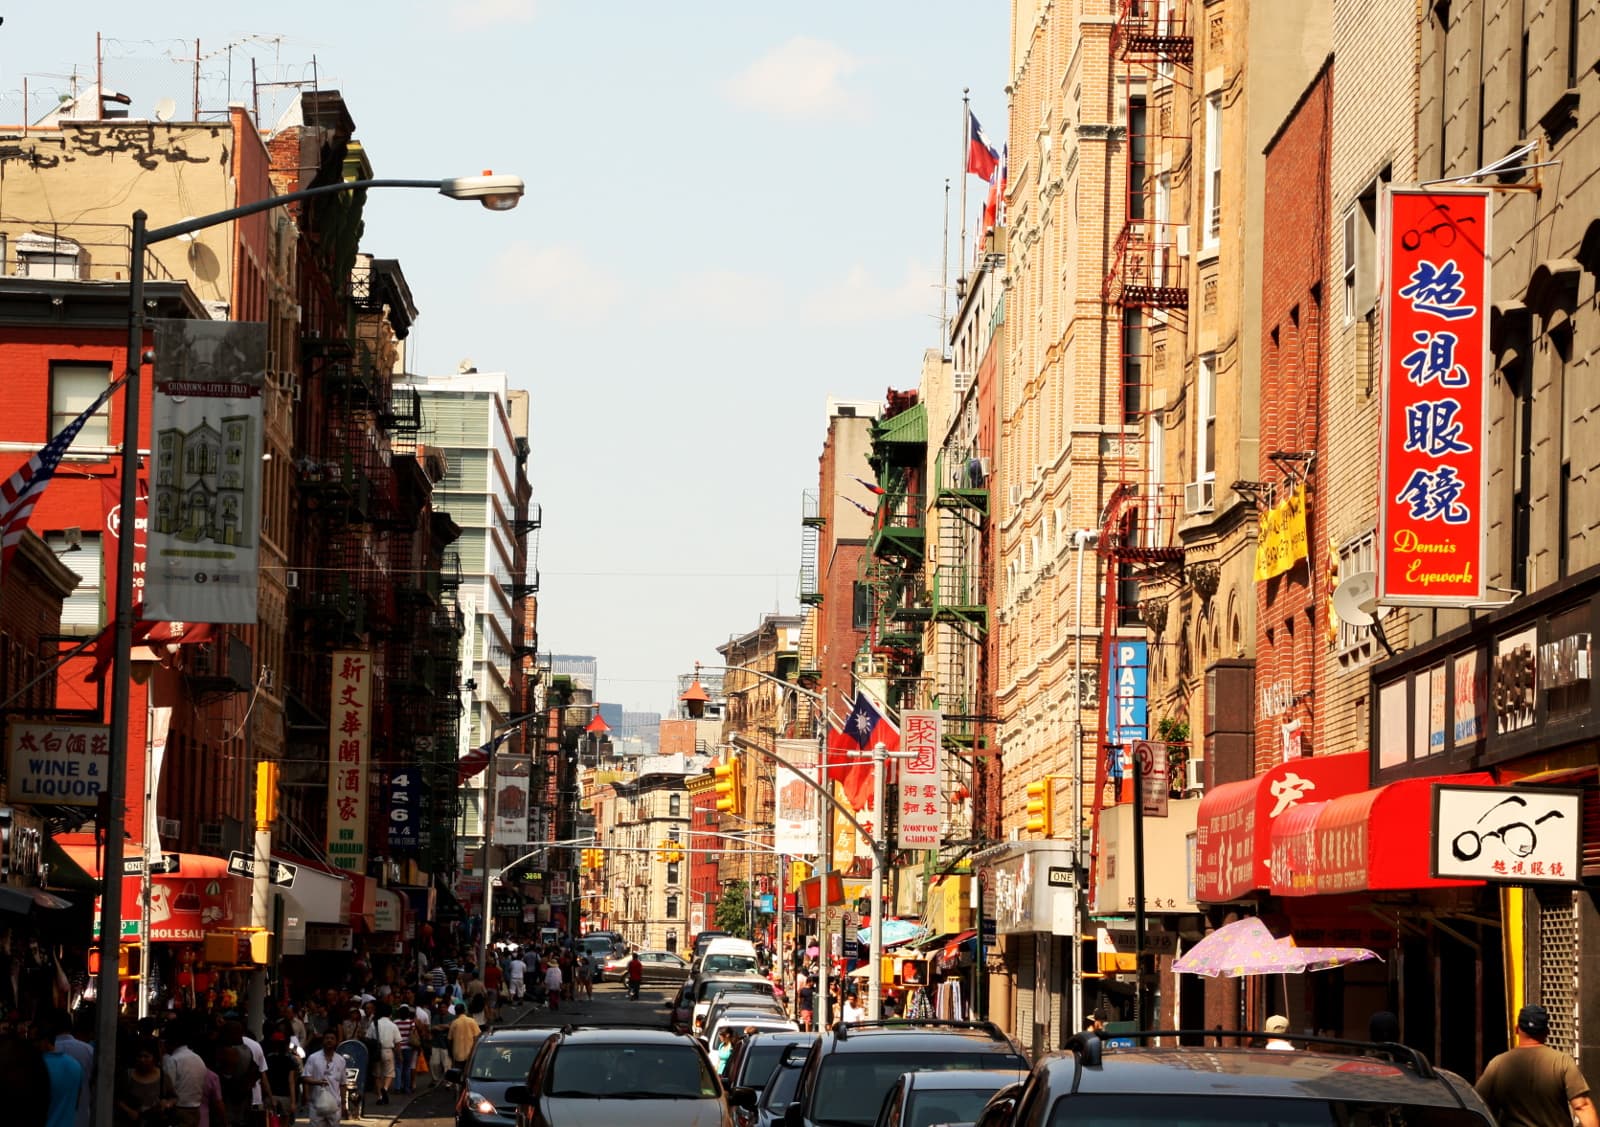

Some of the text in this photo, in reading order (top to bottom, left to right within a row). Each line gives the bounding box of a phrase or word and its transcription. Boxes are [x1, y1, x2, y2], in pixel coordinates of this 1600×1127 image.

[168, 382, 202, 392] CHINATOWN
[207, 384, 230, 393] LITTLE
[231, 384, 248, 393] ITALY
[1393, 528, 1457, 553] Dennis
[1405, 558, 1473, 586] Eyework
[1120, 646, 1136, 726] PARK
[29, 759, 98, 776] WINE &
[21, 778, 100, 796] LIQUOR
[903, 824, 938, 833] WONTON
[238, 860, 255, 872] ONE
[1053, 872, 1073, 881] ONE
